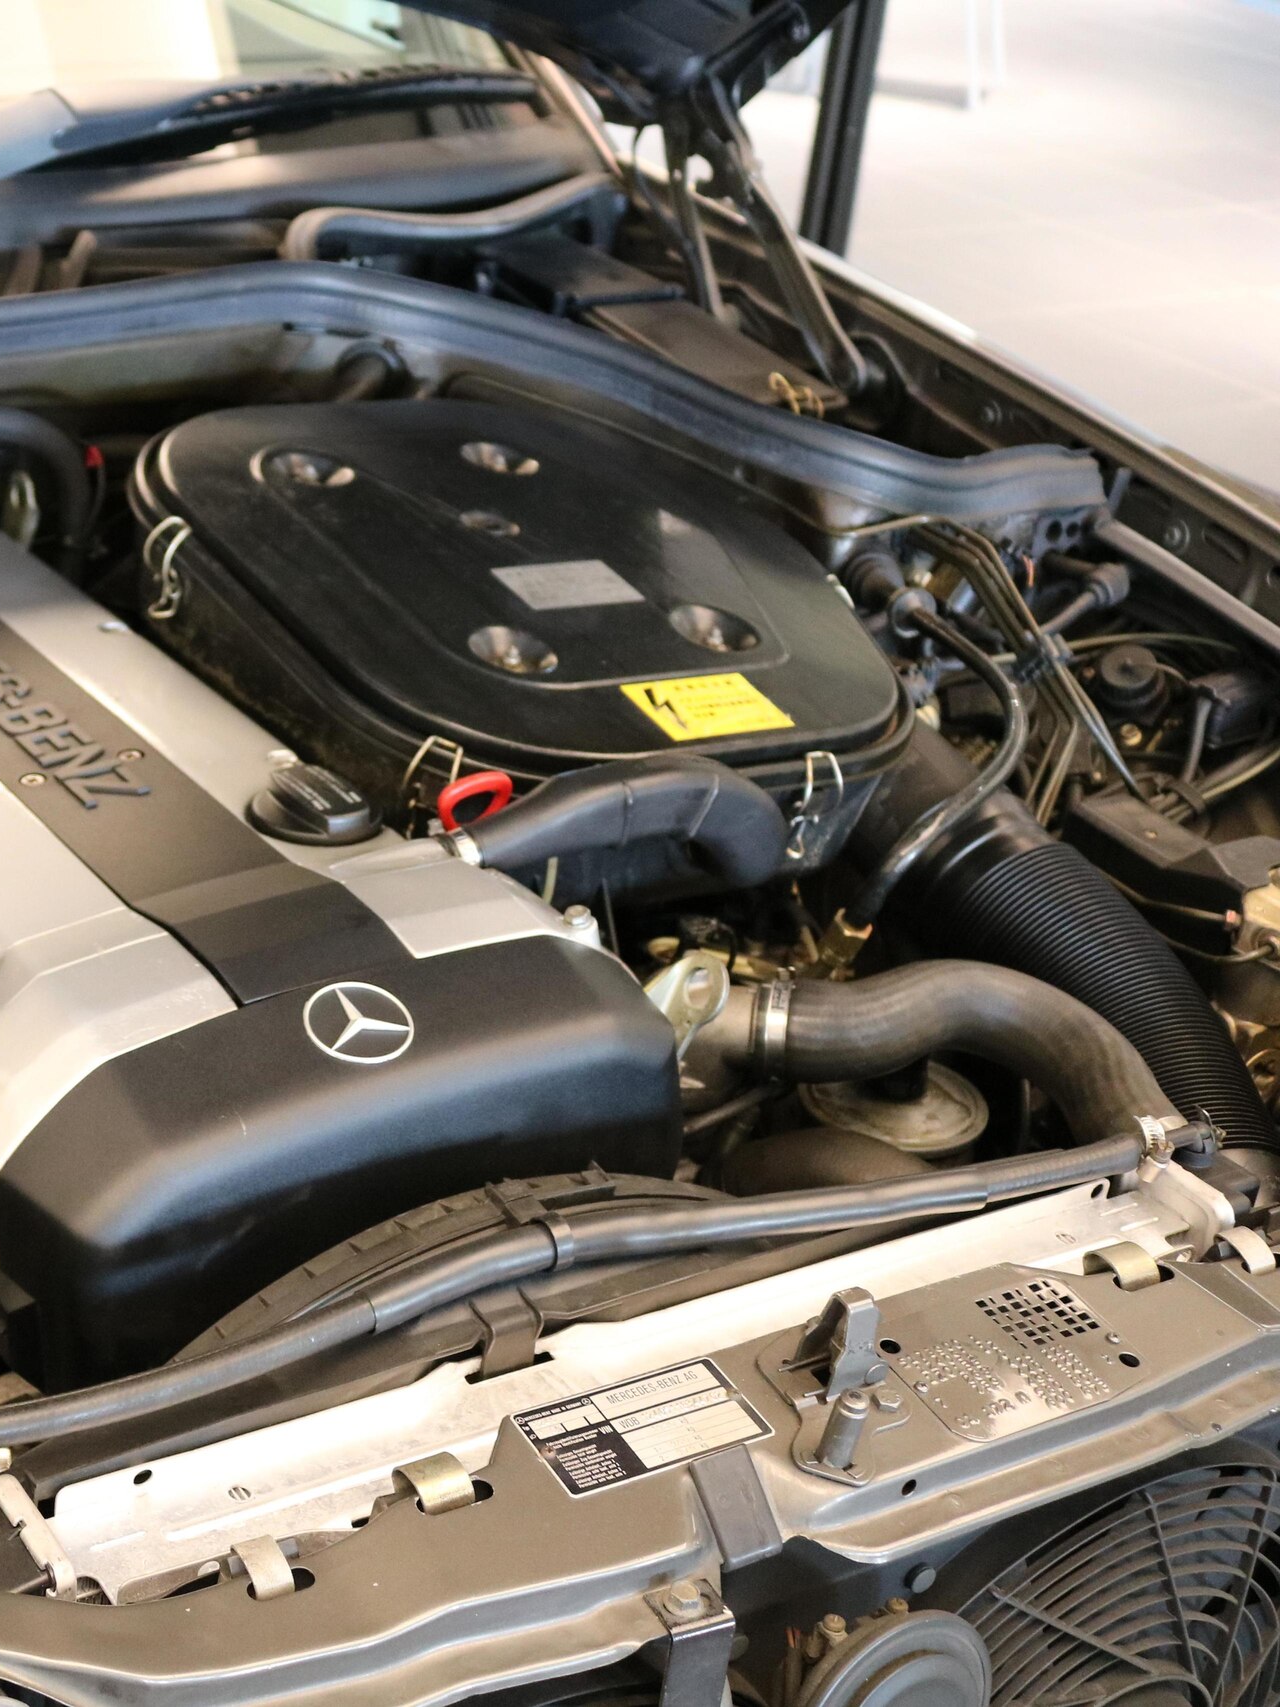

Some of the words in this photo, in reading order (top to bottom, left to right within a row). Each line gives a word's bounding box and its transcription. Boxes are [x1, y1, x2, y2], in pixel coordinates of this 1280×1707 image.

[606, 1375, 681, 1404] MERCEDES-BENZ
[684, 1370, 699, 1382] AG
[618, 1416, 641, 1430] WDB
